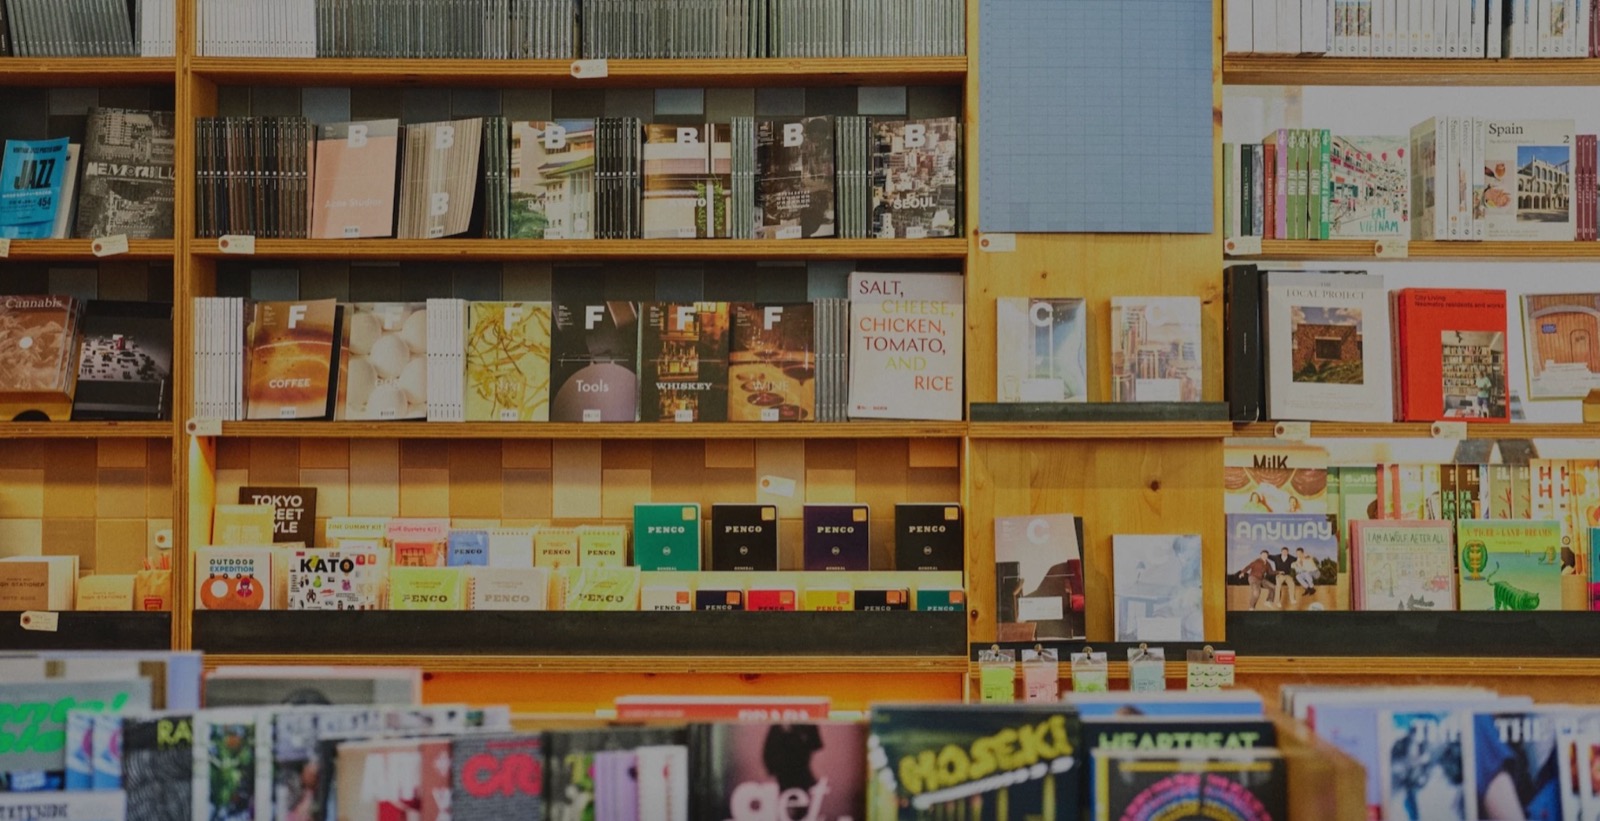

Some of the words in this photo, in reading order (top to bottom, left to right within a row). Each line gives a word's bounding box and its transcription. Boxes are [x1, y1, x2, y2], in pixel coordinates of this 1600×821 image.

[348, 124, 368, 148] B
[435, 126, 454, 149] B
[544, 126, 566, 149] B
[677, 127, 699, 147] B
[784, 123, 804, 148] B
[905, 124, 926, 148] B
[1488, 123, 1524, 137] Spain
[1562, 136, 1570, 144] 2
[14, 158, 55, 190] JAZZ
[430, 192, 450, 216] B
[892, 196, 936, 210] SEOUL
[1360, 218, 1399, 233] VIETNAM
[859, 280, 904, 297] SALT,
[1286, 288, 1317, 298] LOCAL
[1322, 290, 1364, 300] PROJECT
[5, 297, 62, 310] Cannabis
[881, 300, 955, 318] CHEESE,
[288, 305, 307, 329] F
[504, 306, 524, 330] F
[586, 306, 605, 330] F
[676, 306, 696, 330] F
[764, 306, 784, 330] F
[1030, 302, 1054, 327] C
[859, 318, 946, 336] CHICKEN,
[863, 336, 946, 355] TOMATO,
[885, 356, 926, 371] AND
[268, 378, 311, 389] COFFEE
[576, 380, 609, 392] Tools
[656, 381, 712, 391] WHISKEY
[914, 376, 954, 391] RICE
[252, 494, 304, 507] TOKYO
[274, 522, 298, 534] YLE
[648, 526, 686, 534] PENCO
[725, 526, 763, 534] PENCO
[816, 526, 854, 534] PENCO
[908, 526, 946, 534] PENCO
[1027, 518, 1050, 544] C
[454, 548, 482, 556] PENCO
[543, 548, 571, 556] PENCO
[209, 558, 254, 566] OUTDOOR
[300, 559, 354, 572] KATO
[402, 594, 448, 603] PENCO
[484, 594, 530, 603] PENCO
[1099, 731, 1260, 750] HEARTBEAT
